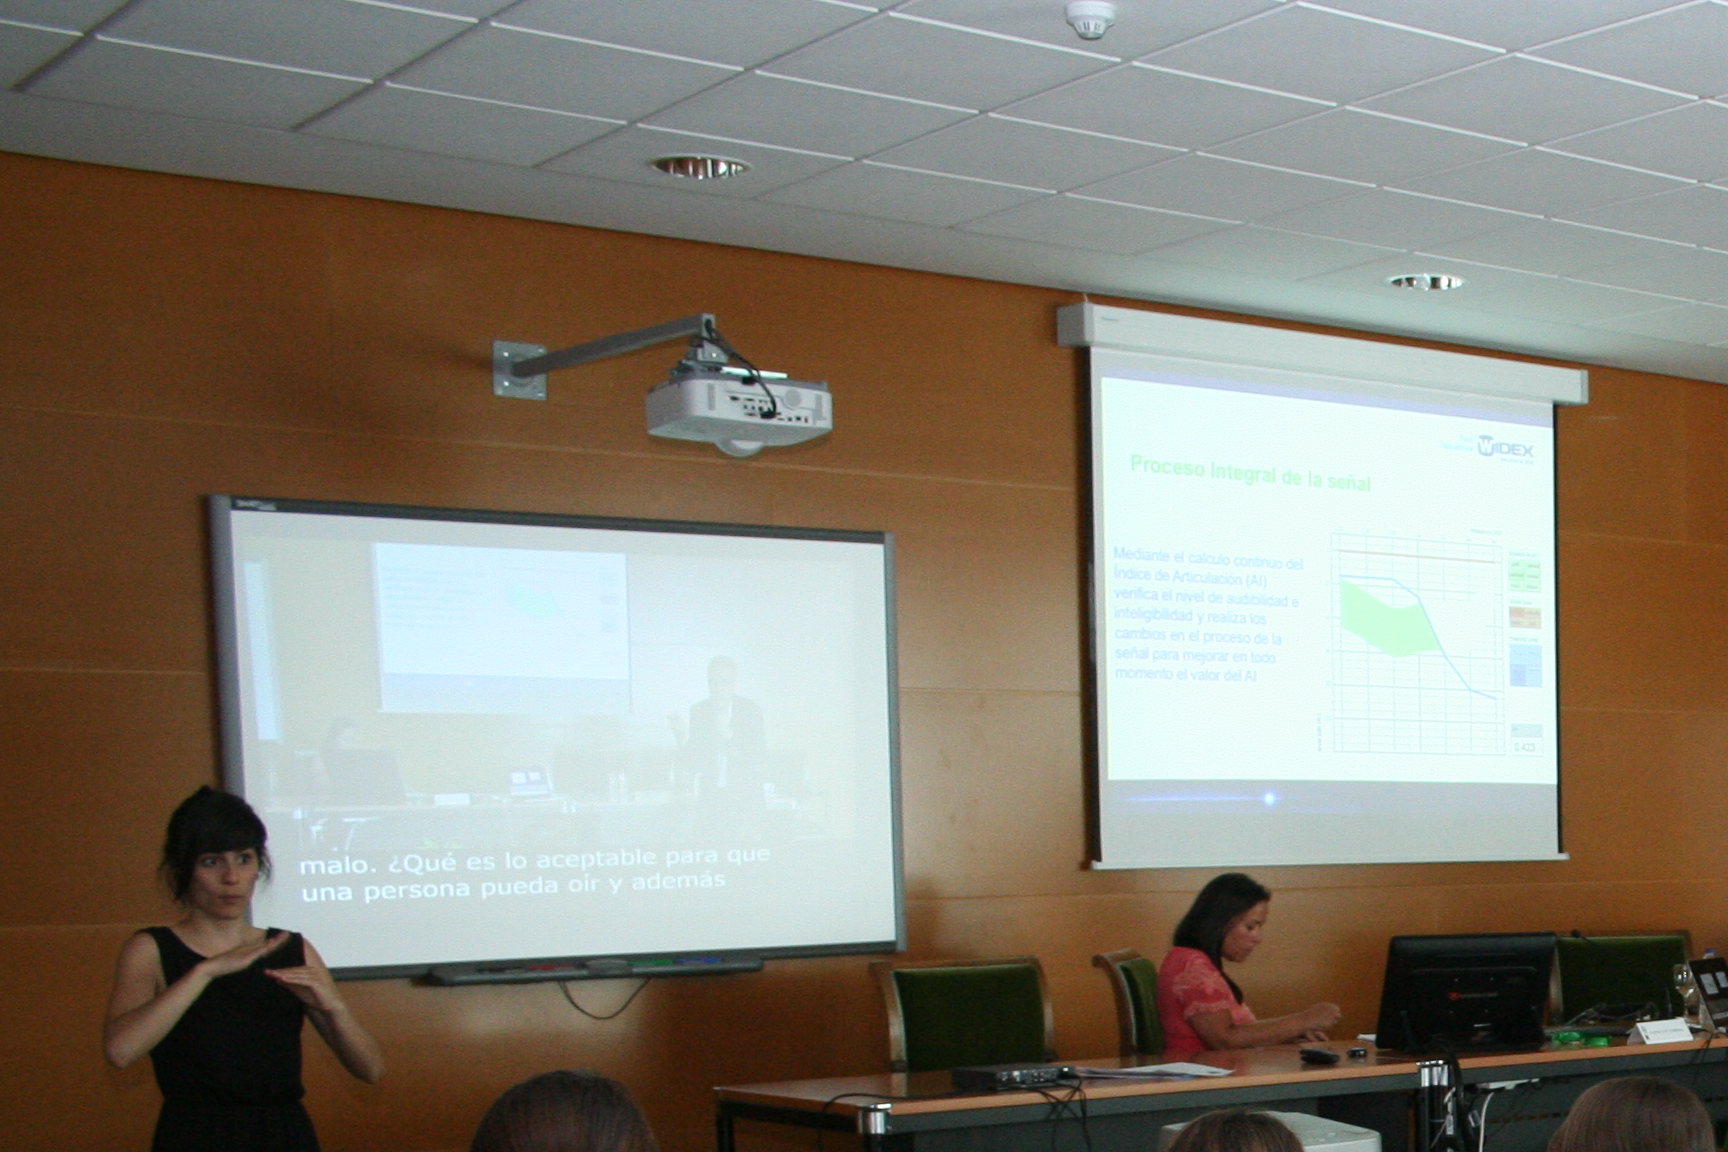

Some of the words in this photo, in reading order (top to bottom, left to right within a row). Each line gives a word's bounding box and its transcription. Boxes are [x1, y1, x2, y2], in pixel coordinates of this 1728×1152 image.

[1477, 434, 1535, 458] WIDEX
[1130, 453, 1206, 478] Proceso
[1282, 468, 1302, 486] de
[1308, 470, 1323, 488] la
[1327, 473, 1371, 492] señal
[1113, 546, 1170, 562] Mediante
[1173, 551, 1185, 563] el
[1233, 555, 1284, 569] continuo
[1286, 558, 1304, 570] del
[1154, 569, 1170, 582] de
[1114, 587, 1159, 601] verifica
[1161, 589, 1173, 601] el
[1175, 590, 1204, 603] nivel
[1208, 592, 1223, 604] de
[1207, 611, 1247, 624] realiza
[1250, 613, 1267, 625] los
[1114, 627, 1166, 641] cambios
[1170, 630, 1185, 641] en
[1188, 629, 1200, 642] el
[1203, 632, 1251, 645] proceso
[1254, 633, 1269, 645] de
[1271, 633, 1282, 645] la
[1115, 646, 1149, 660] señal
[1152, 650, 1179, 663] para
[1183, 650, 1229, 665] mejorar
[1233, 652, 1247, 663] en
[1250, 652, 1276, 664] todo
[1115, 668, 1173, 680] momento
[1176, 669, 1187, 681] el
[1191, 669, 1221, 681] valor
[1224, 670, 1242, 682] del
[300, 856, 377, 875] malo.
[388, 852, 456, 875] ¿Qué
[466, 856, 496, 871] es
[505, 852, 527, 869] lo
[537, 848, 658, 870] aceptable
[666, 848, 719, 867] para
[727, 848, 770, 865] que
[302, 886, 353, 902] una
[364, 881, 471, 903] persona
[480, 876, 558, 899] pueda
[609, 878, 623, 894] y
[632, 870, 726, 890] además
